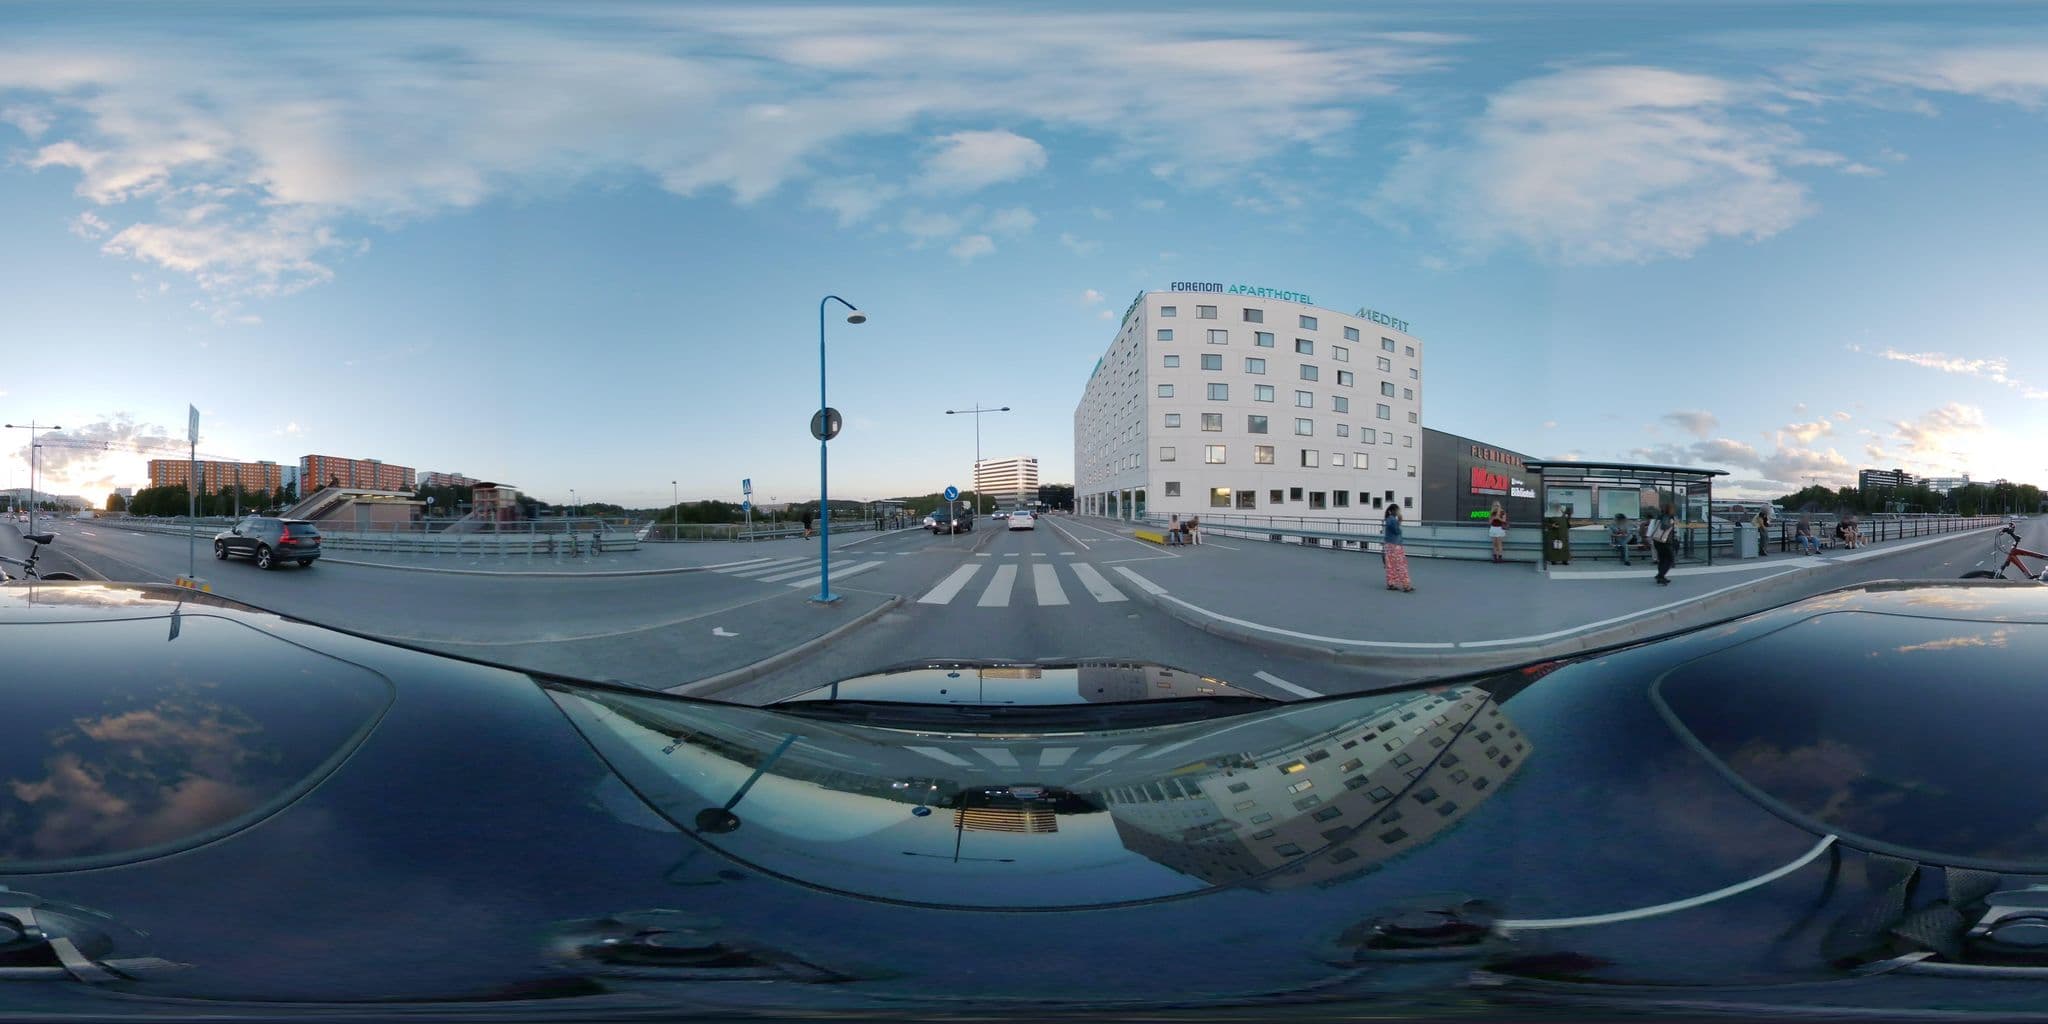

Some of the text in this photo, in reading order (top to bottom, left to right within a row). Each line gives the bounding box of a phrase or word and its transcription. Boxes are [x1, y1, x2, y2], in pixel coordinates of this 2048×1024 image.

[1171, 281, 1313, 304] FORENOM APARTHOTEL
[1355, 307, 1409, 332] MEDFIT
